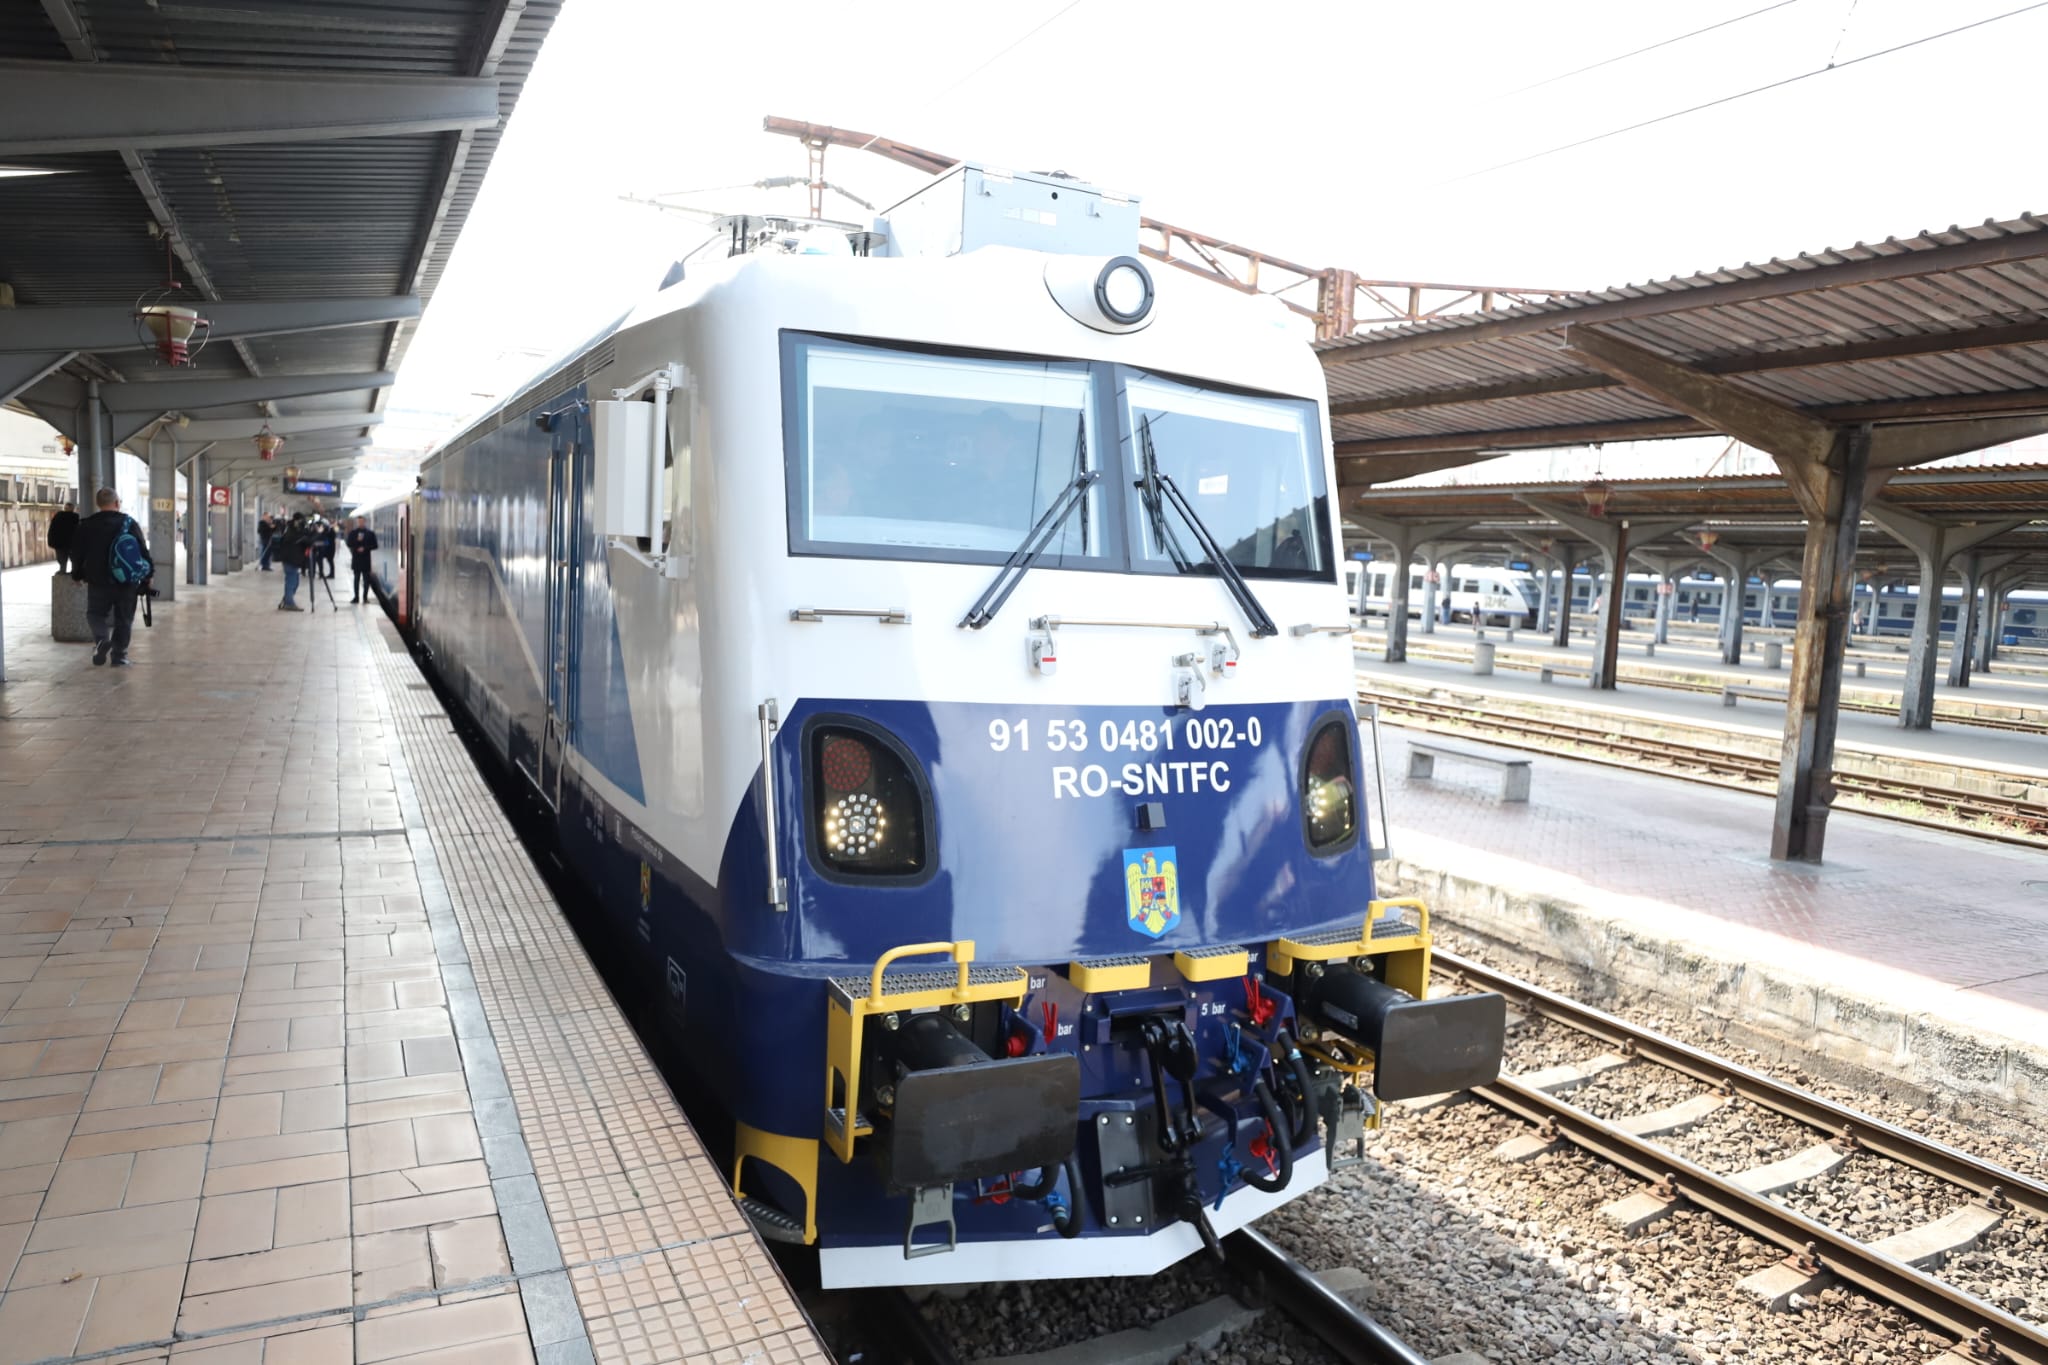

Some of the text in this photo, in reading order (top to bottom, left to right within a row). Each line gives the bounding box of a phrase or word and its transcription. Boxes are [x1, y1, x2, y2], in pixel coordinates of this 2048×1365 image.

[988, 717, 1262, 752] 91 53 0481 002-0
[1052, 761, 1230, 799] RO-SNTFC
[1030, 976, 1046, 990] bar
[1201, 1002, 1226, 1016] 5 bar
[1057, 1023, 1073, 1036] bar
